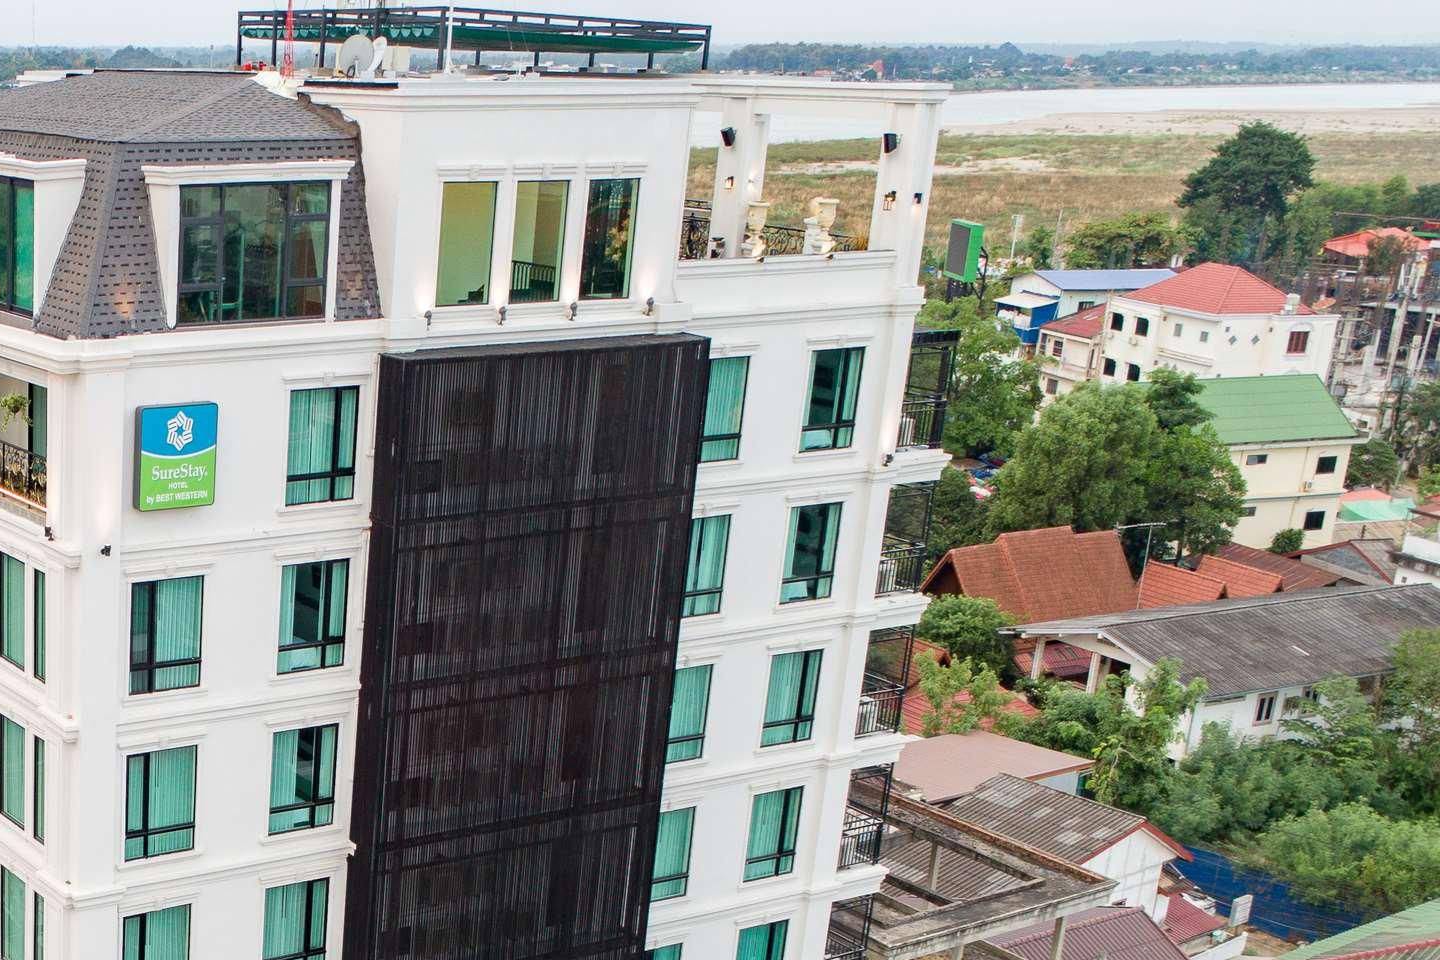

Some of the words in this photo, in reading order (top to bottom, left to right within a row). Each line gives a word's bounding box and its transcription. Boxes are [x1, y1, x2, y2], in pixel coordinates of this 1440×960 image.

[152, 464, 207, 481] SureStay
[168, 481, 188, 489] HOTEL
[146, 495, 155, 504] by
[156, 493, 174, 503] BEST
[175, 490, 208, 500] WESTERN
